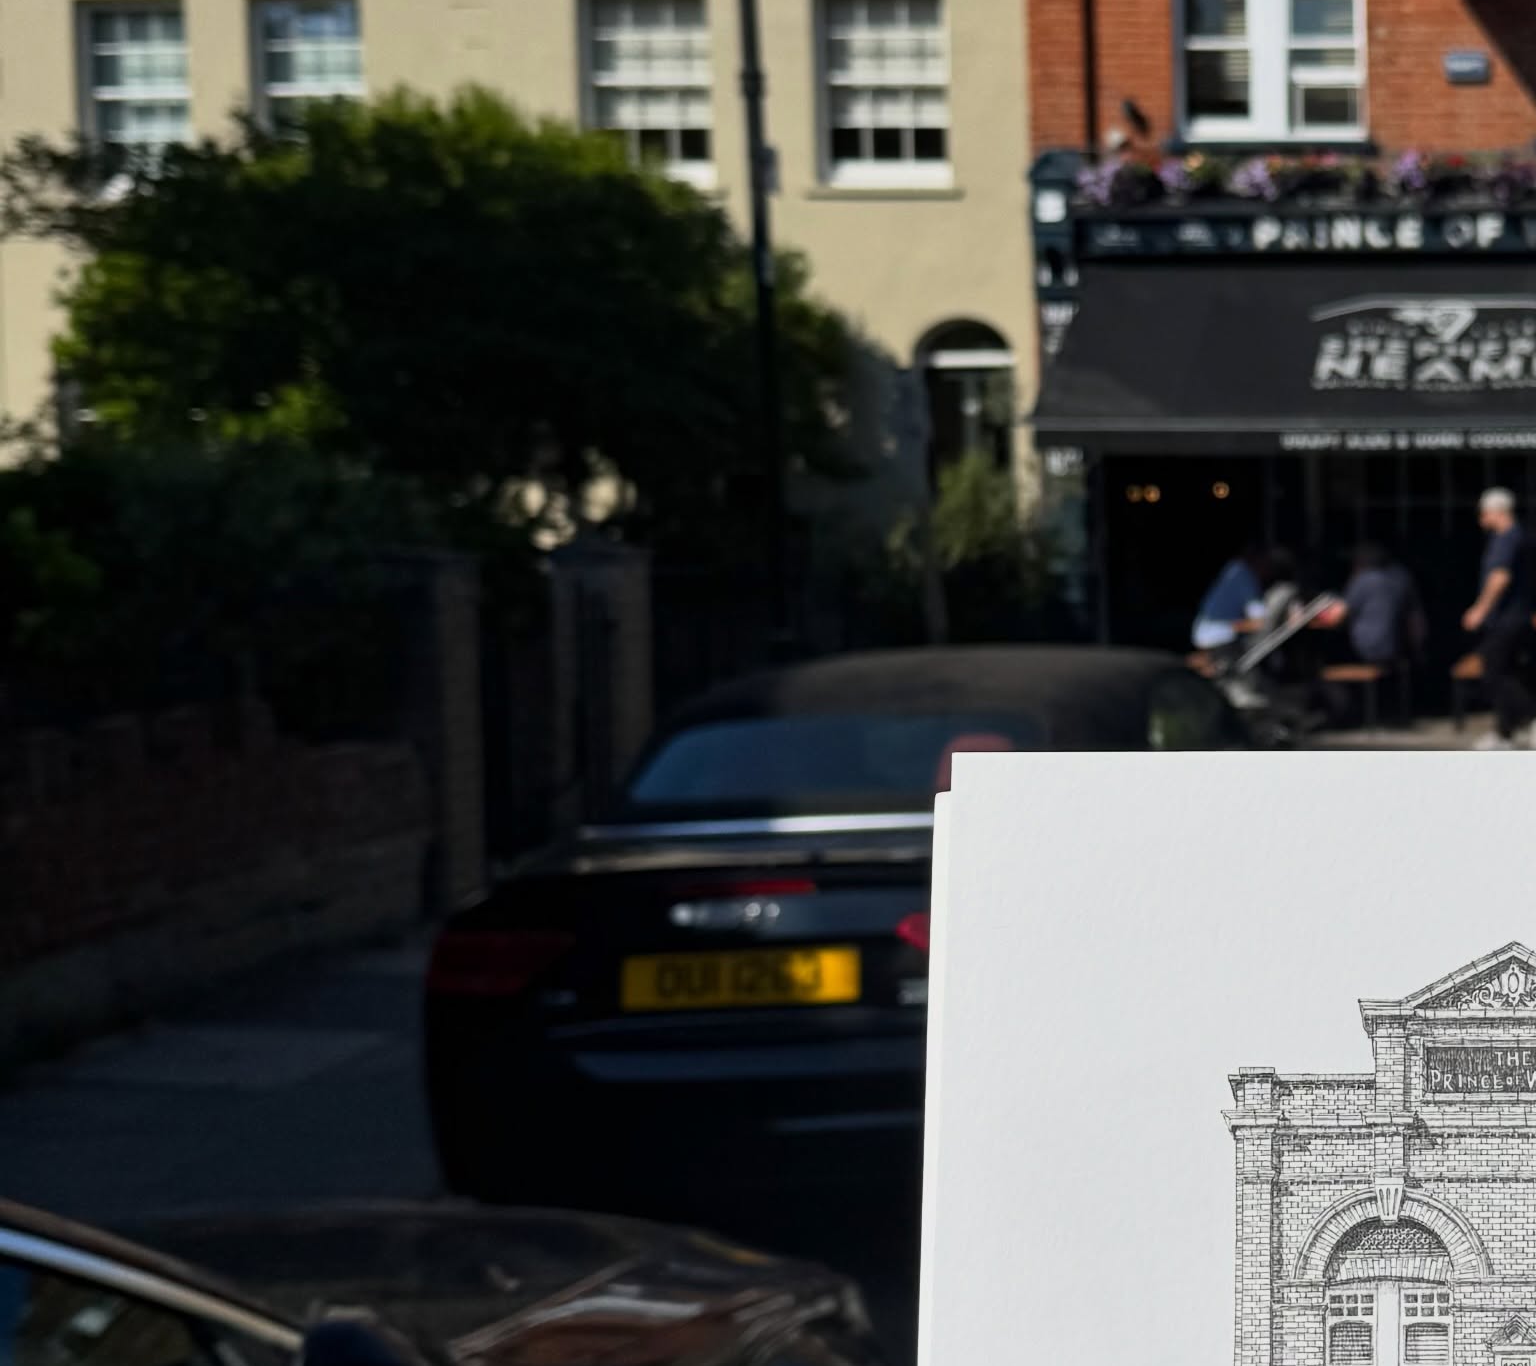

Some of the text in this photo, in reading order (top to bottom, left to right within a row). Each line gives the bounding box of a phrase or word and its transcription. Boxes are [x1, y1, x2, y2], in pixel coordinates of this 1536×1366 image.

[1253, 214, 1422, 249] PRINCE
[1444, 213, 1504, 248] OF
[1495, 1051, 1532, 1066] THE
[1431, 1069, 1504, 1090] PRINCE
